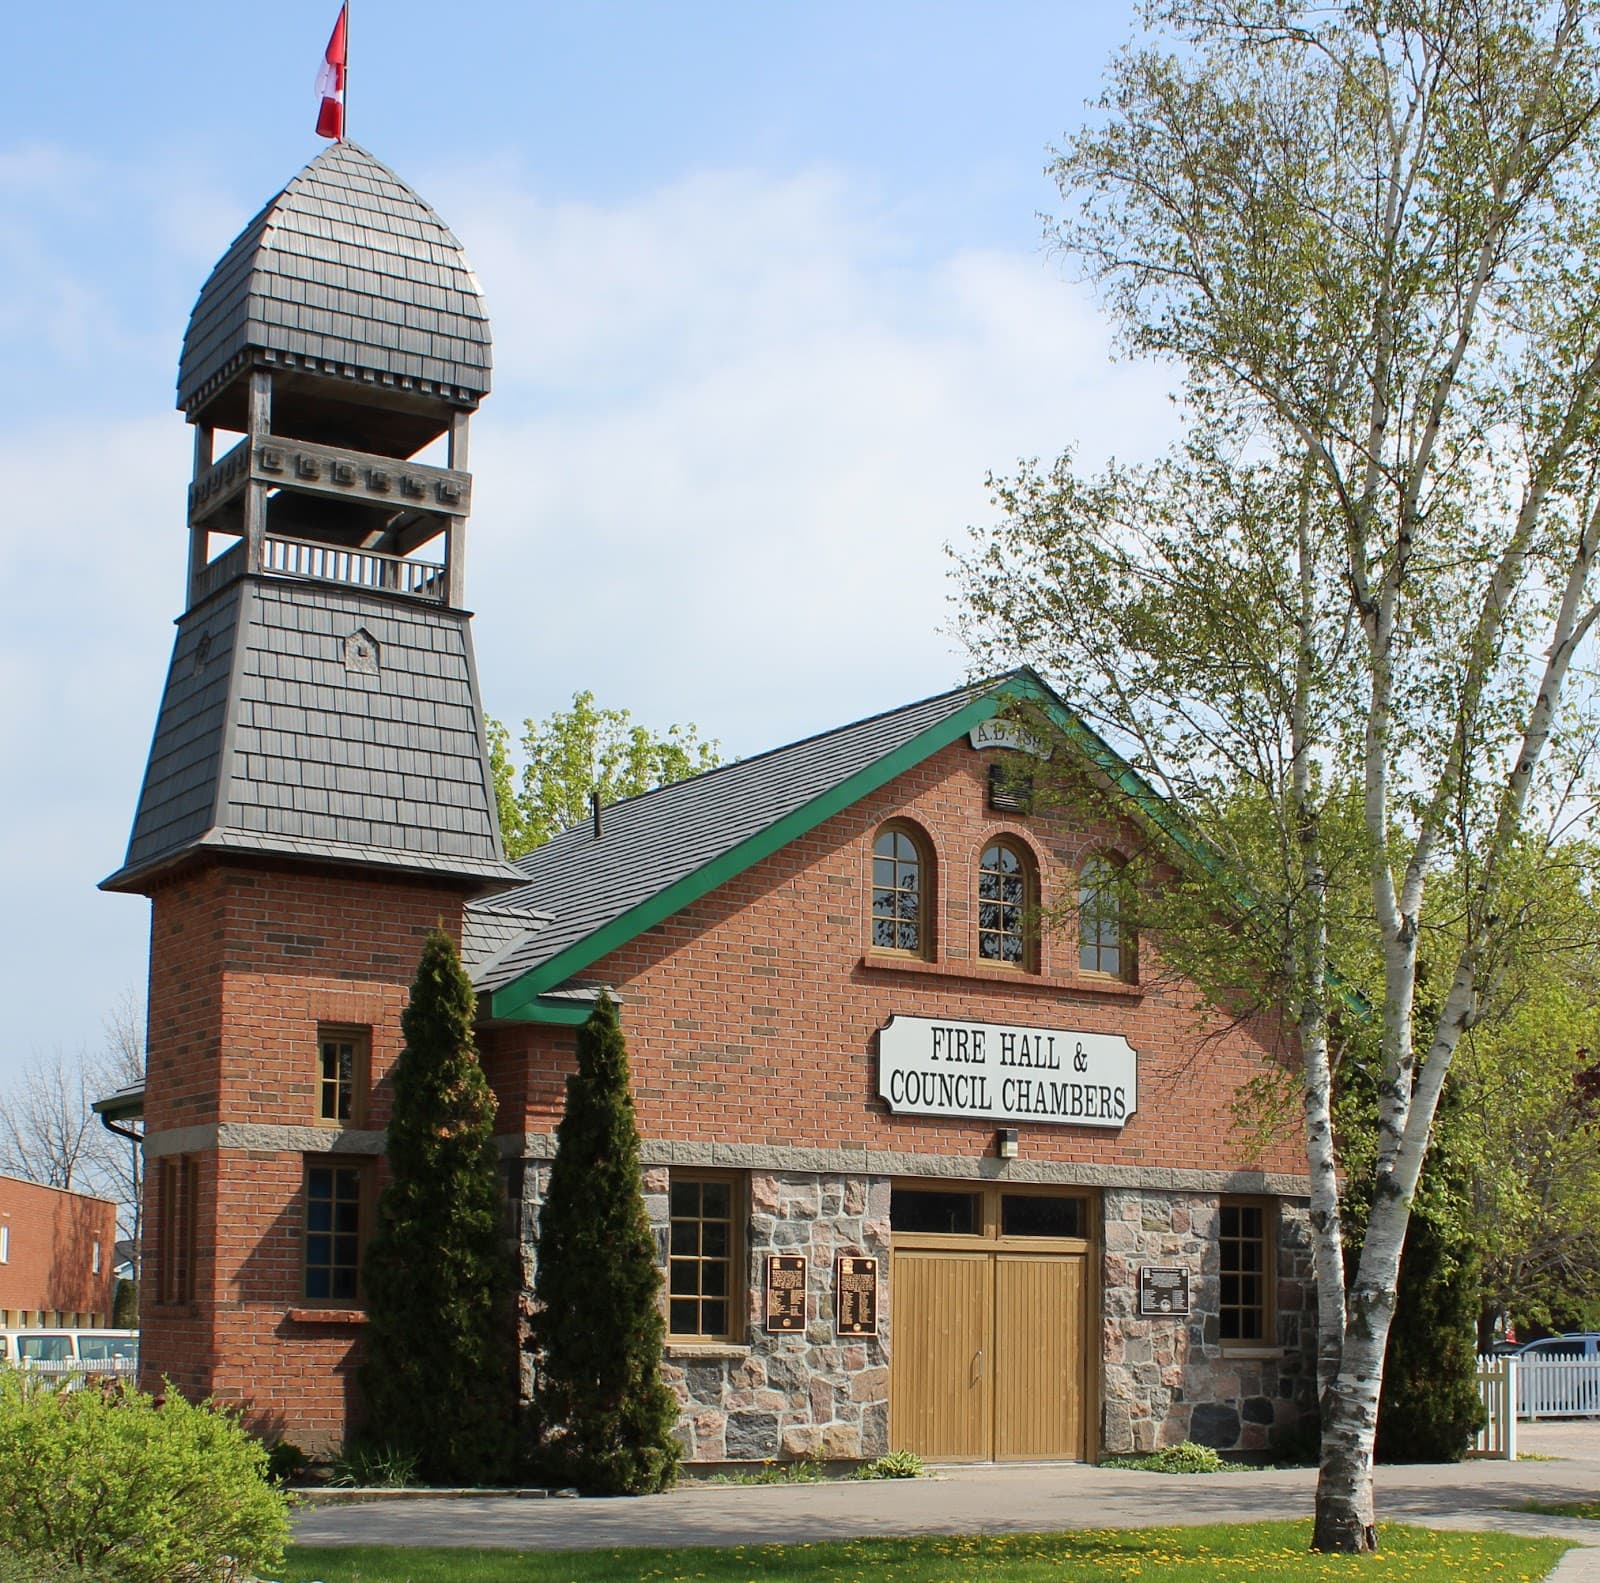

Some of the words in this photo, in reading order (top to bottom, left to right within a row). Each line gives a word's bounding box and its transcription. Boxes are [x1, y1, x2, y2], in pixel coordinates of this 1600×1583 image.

[977, 722, 1009, 742] A.D.
[930, 1026, 986, 1064] FIRE
[1000, 1032, 1060, 1070] HALL
[1073, 1042, 1088, 1073] &
[890, 1069, 992, 1110] COUNCIL
[1002, 1078, 1126, 1120] CHAMBERS
